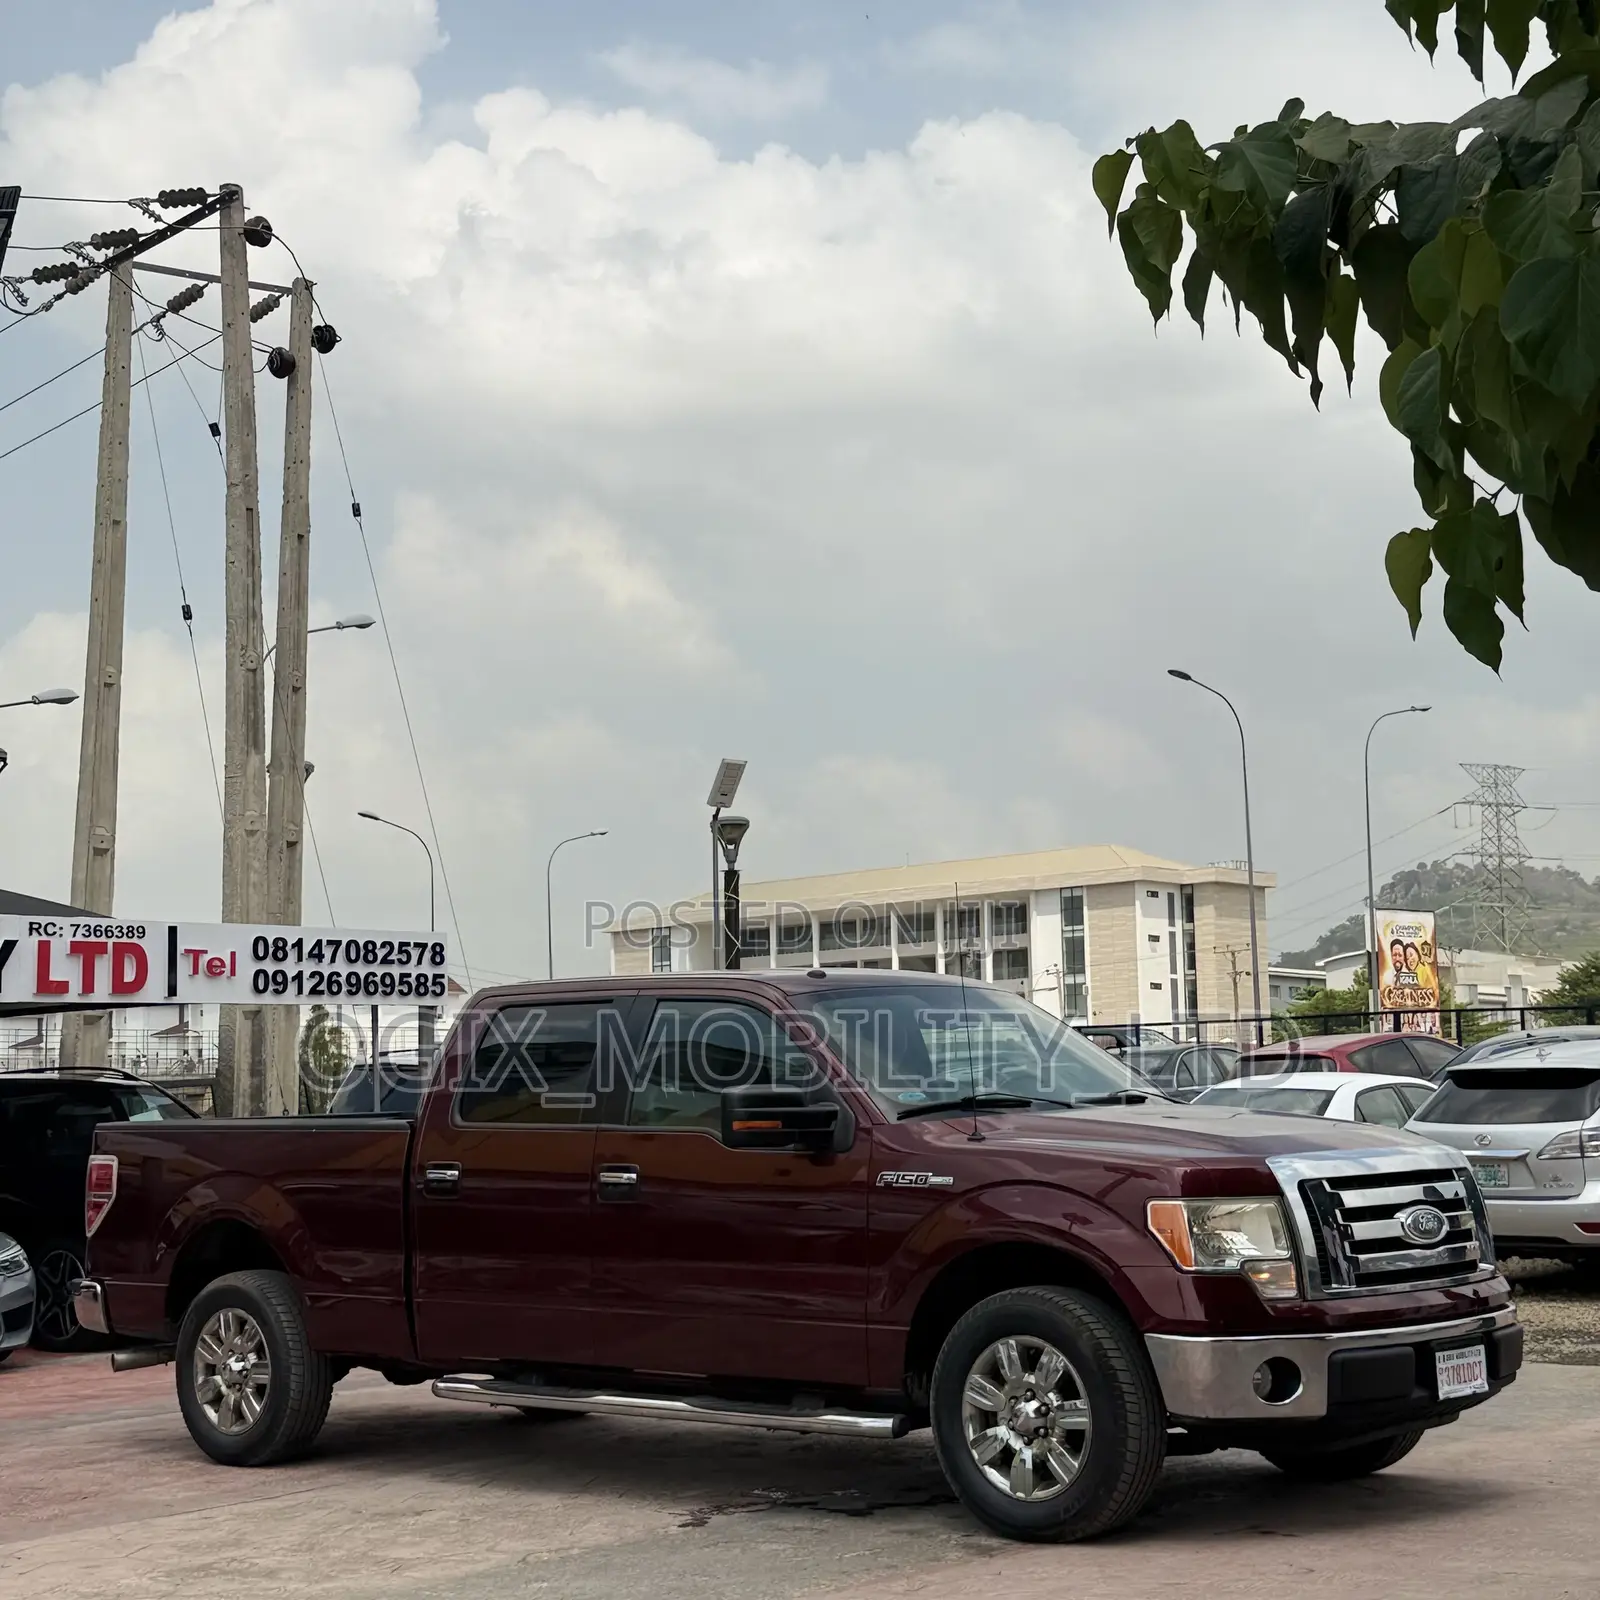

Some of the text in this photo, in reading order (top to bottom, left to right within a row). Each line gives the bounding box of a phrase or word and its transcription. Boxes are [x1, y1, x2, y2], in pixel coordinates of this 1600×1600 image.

[28, 921, 146, 939] RC: 7366389
[183, 948, 237, 978] Tel
[252, 936, 446, 967] 08147082578
[35, 939, 149, 995] LTD
[252, 968, 446, 997] 09126969585
